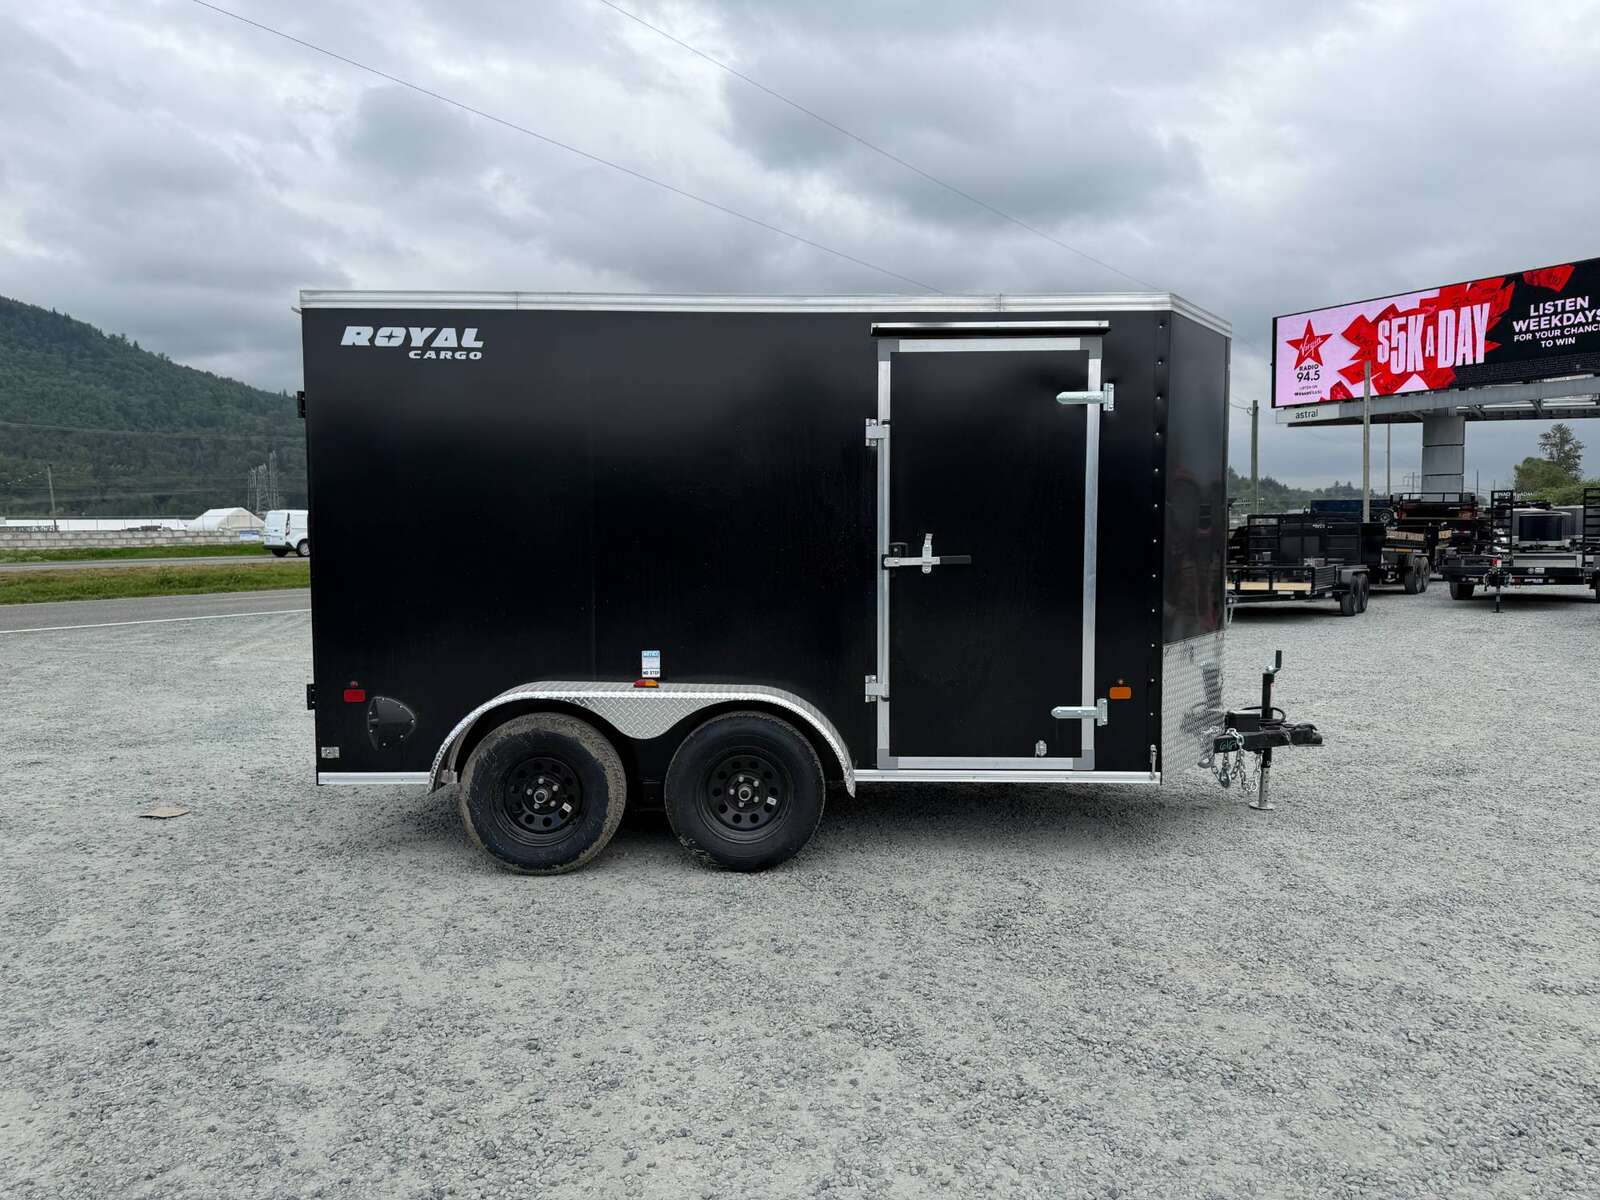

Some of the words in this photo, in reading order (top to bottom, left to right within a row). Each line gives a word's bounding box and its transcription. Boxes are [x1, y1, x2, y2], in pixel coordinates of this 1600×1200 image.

[1530, 296, 1589, 316] LISTEN
[341, 326, 484, 348] ROYAL
[1377, 314, 1425, 374] $5K
[1425, 325, 1434, 357] A
[1437, 303, 1490, 368] DAY
[1514, 333, 1532, 342] FOR
[1535, 330, 1561, 339] YOUR
[1564, 324, 1600, 335] CHANC
[1299, 334, 1324, 357] Virgin
[1541, 340, 1553, 348] TO
[1556, 337, 1576, 346] WIN
[409, 350, 482, 360] CARGO
[1297, 370, 1320, 382] 94.5
[1295, 409, 1319, 419] astral
